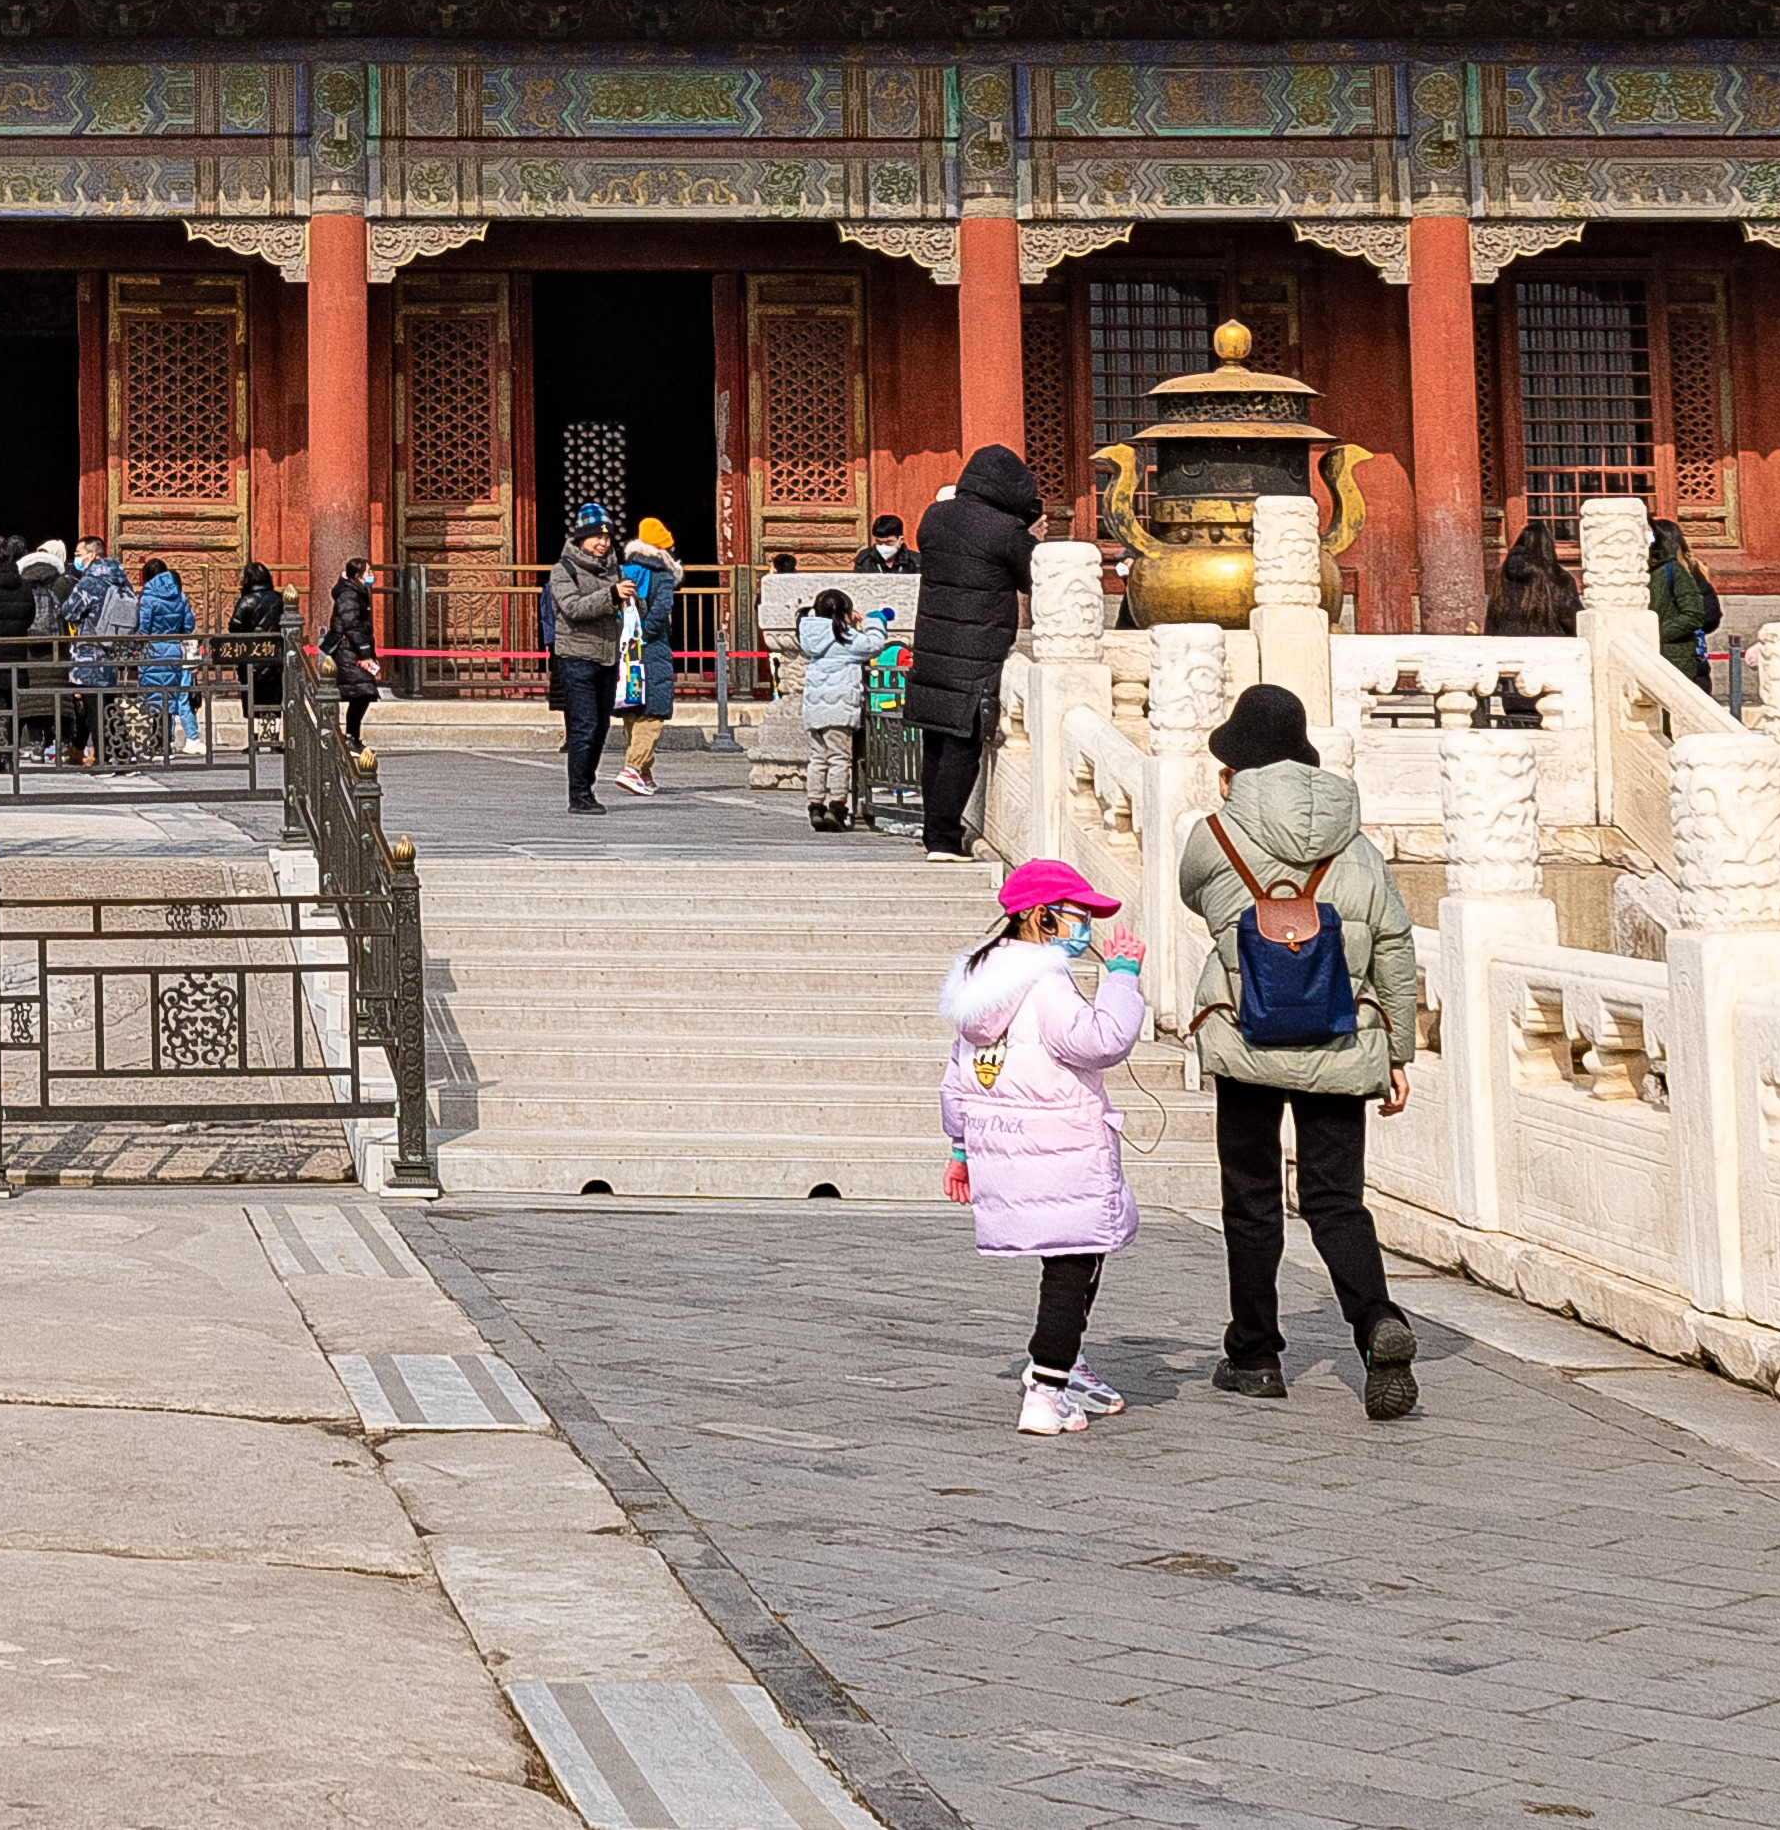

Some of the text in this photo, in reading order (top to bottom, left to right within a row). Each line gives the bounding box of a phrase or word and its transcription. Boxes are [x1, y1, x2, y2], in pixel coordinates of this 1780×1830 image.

[220, 641, 276, 658] 爱护文物
[990, 1115, 1025, 1135] Duck
